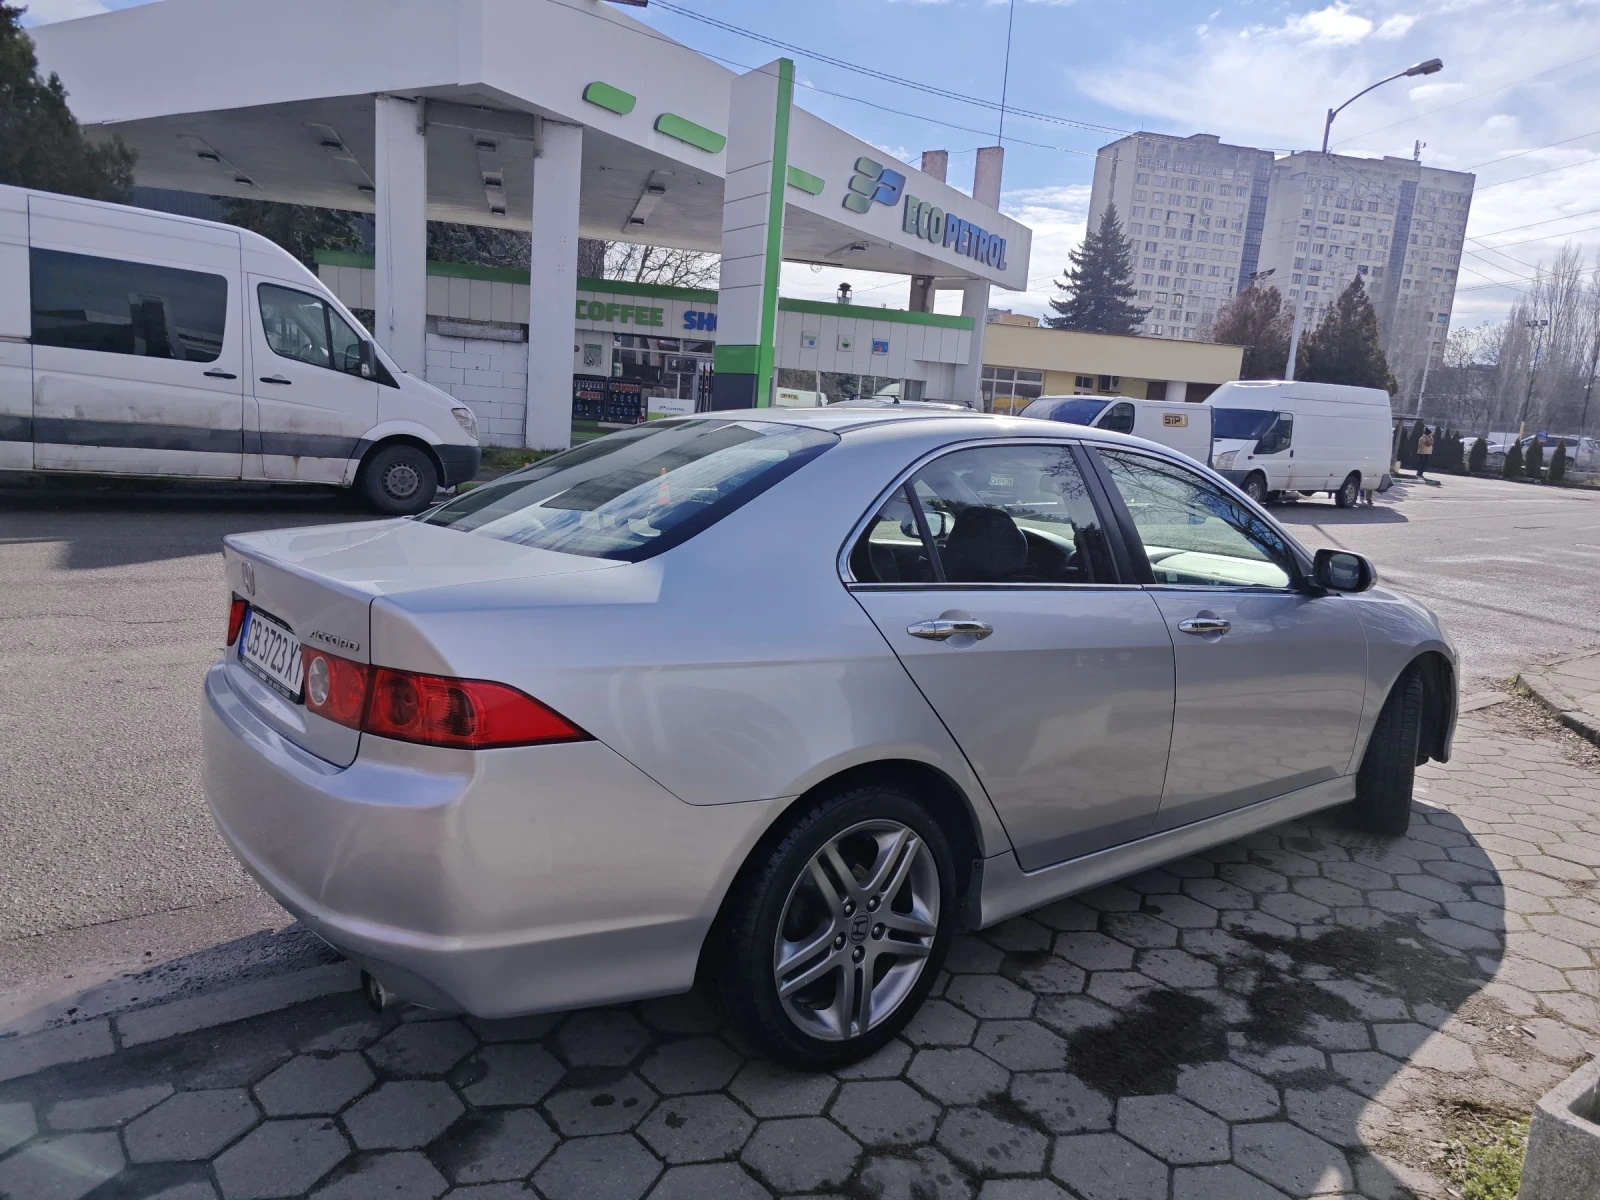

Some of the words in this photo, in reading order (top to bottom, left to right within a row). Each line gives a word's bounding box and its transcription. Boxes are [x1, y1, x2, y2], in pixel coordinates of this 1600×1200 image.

[902, 194, 1007, 270] ECOPETROL
[576, 300, 664, 327] COFFEE
[683, 310, 717, 332] SH
[246, 618, 262, 656] CB
[259, 626, 288, 674] 3723
[309, 630, 360, 652] ACCORD
